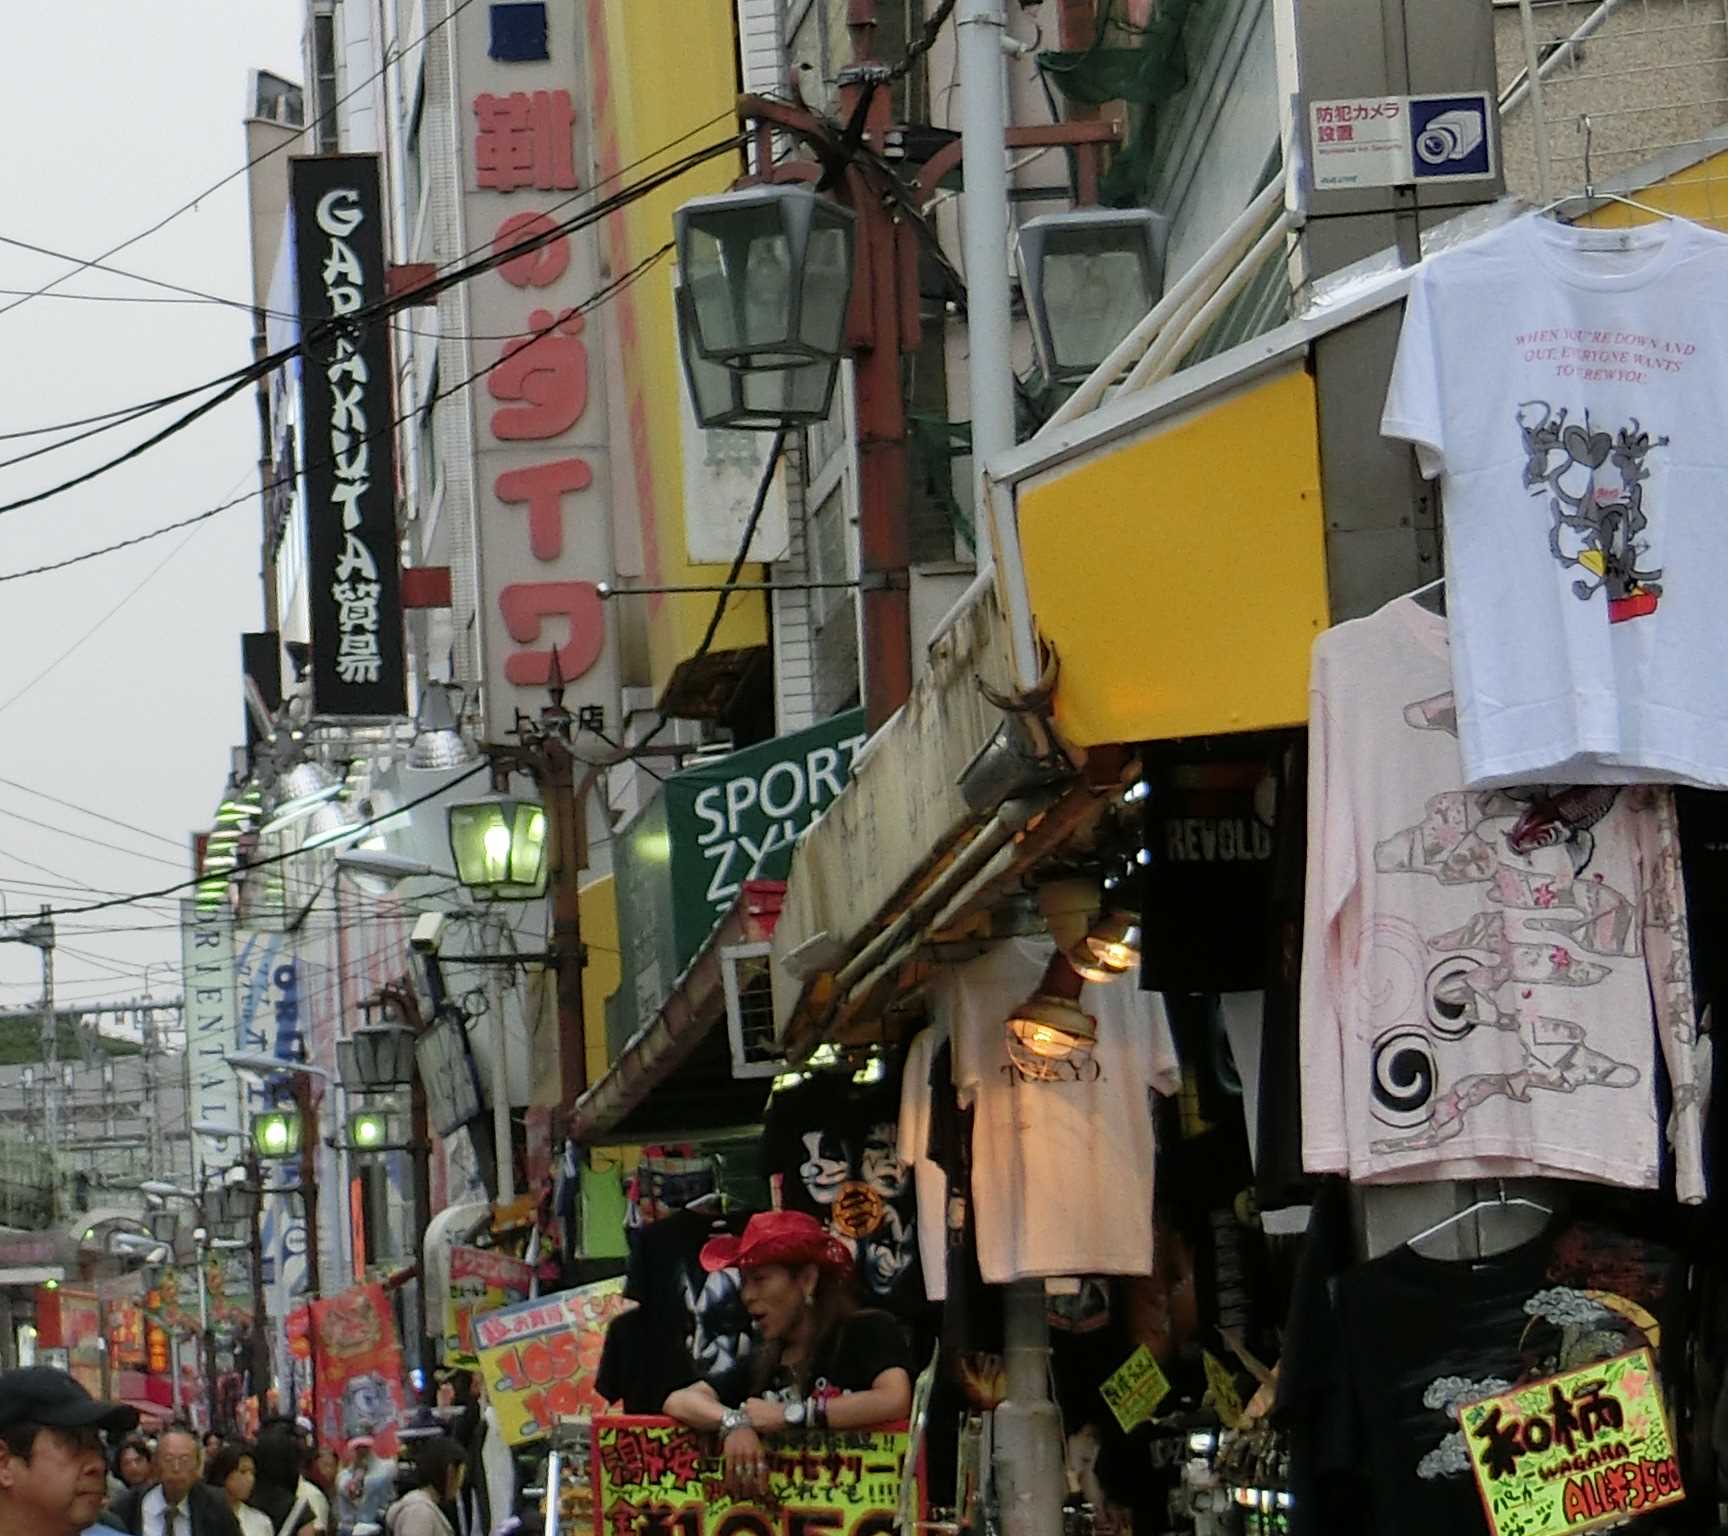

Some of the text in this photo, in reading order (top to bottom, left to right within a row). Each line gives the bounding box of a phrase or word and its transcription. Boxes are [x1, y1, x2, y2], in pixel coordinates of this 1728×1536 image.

[1315, 102, 1400, 123] 防犯カメラ
[1317, 124, 1354, 143] 設置
[1515, 329, 1559, 346] WHEN
[1663, 340, 1696, 356] AND
[472, 88, 604, 686] 靴のダイワ
[503, 704, 604, 741] 上店
